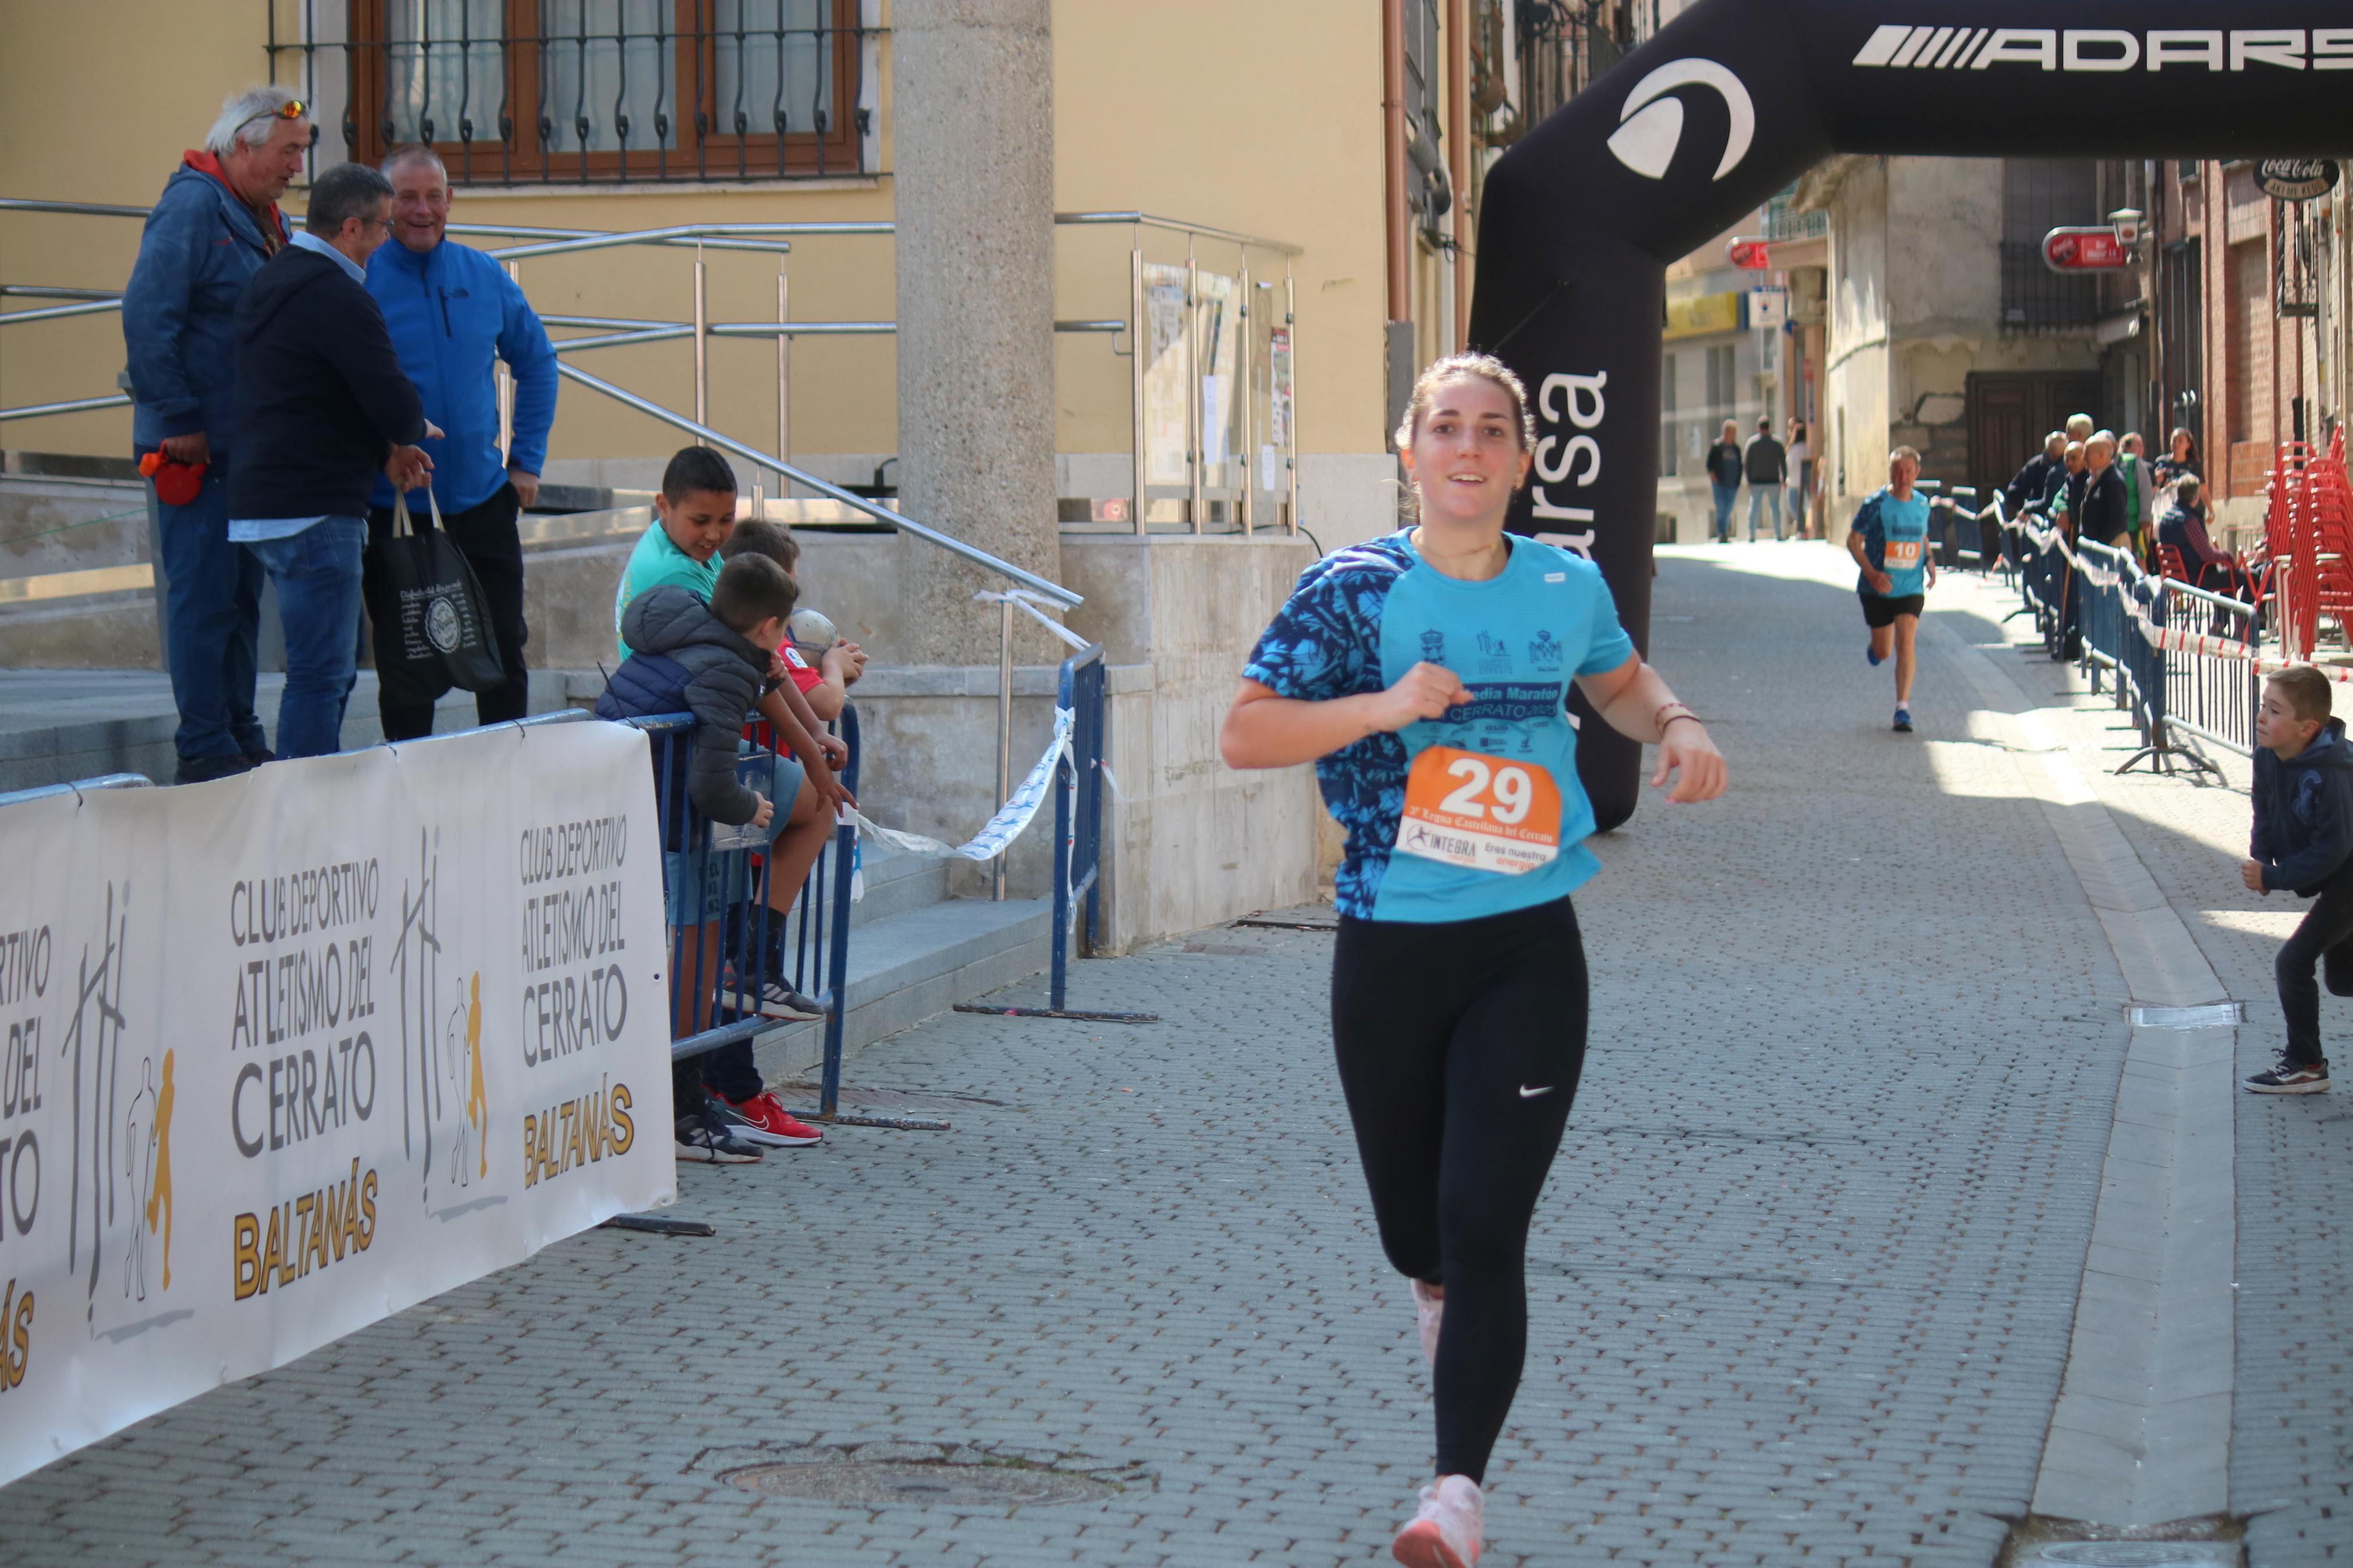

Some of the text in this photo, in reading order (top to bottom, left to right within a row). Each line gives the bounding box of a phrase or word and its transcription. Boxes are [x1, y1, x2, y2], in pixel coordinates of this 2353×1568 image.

[1895, 543, 1916, 557] 10
[1450, 703, 1525, 721] CERRATO
[1467, 687, 1558, 701] edia Maratón
[1422, 808, 1453, 824] Legua
[1455, 816, 1503, 833] Castellana
[1504, 825, 1517, 835] del
[1519, 827, 1553, 842] Cerrato
[1439, 758, 1532, 824] 29
[521, 813, 627, 886] CLUB DEPORTIVO
[1429, 834, 1477, 857] INTEGRA
[1485, 842, 1546, 862] Eres nuestra
[231, 858, 379, 947] CLUB DEPORTIVO
[521, 885, 595, 975] ATLETISMO
[598, 880, 625, 955] DEL
[232, 935, 375, 1050] ATLETISMO DEL
[523, 963, 627, 1068] CERRATO
[3, 1016, 42, 1120] DEL
[232, 1030, 376, 1158] CERRATO
[524, 1072, 636, 1191] BALTANÁS
[234, 1157, 378, 1302] BALTANÁS
